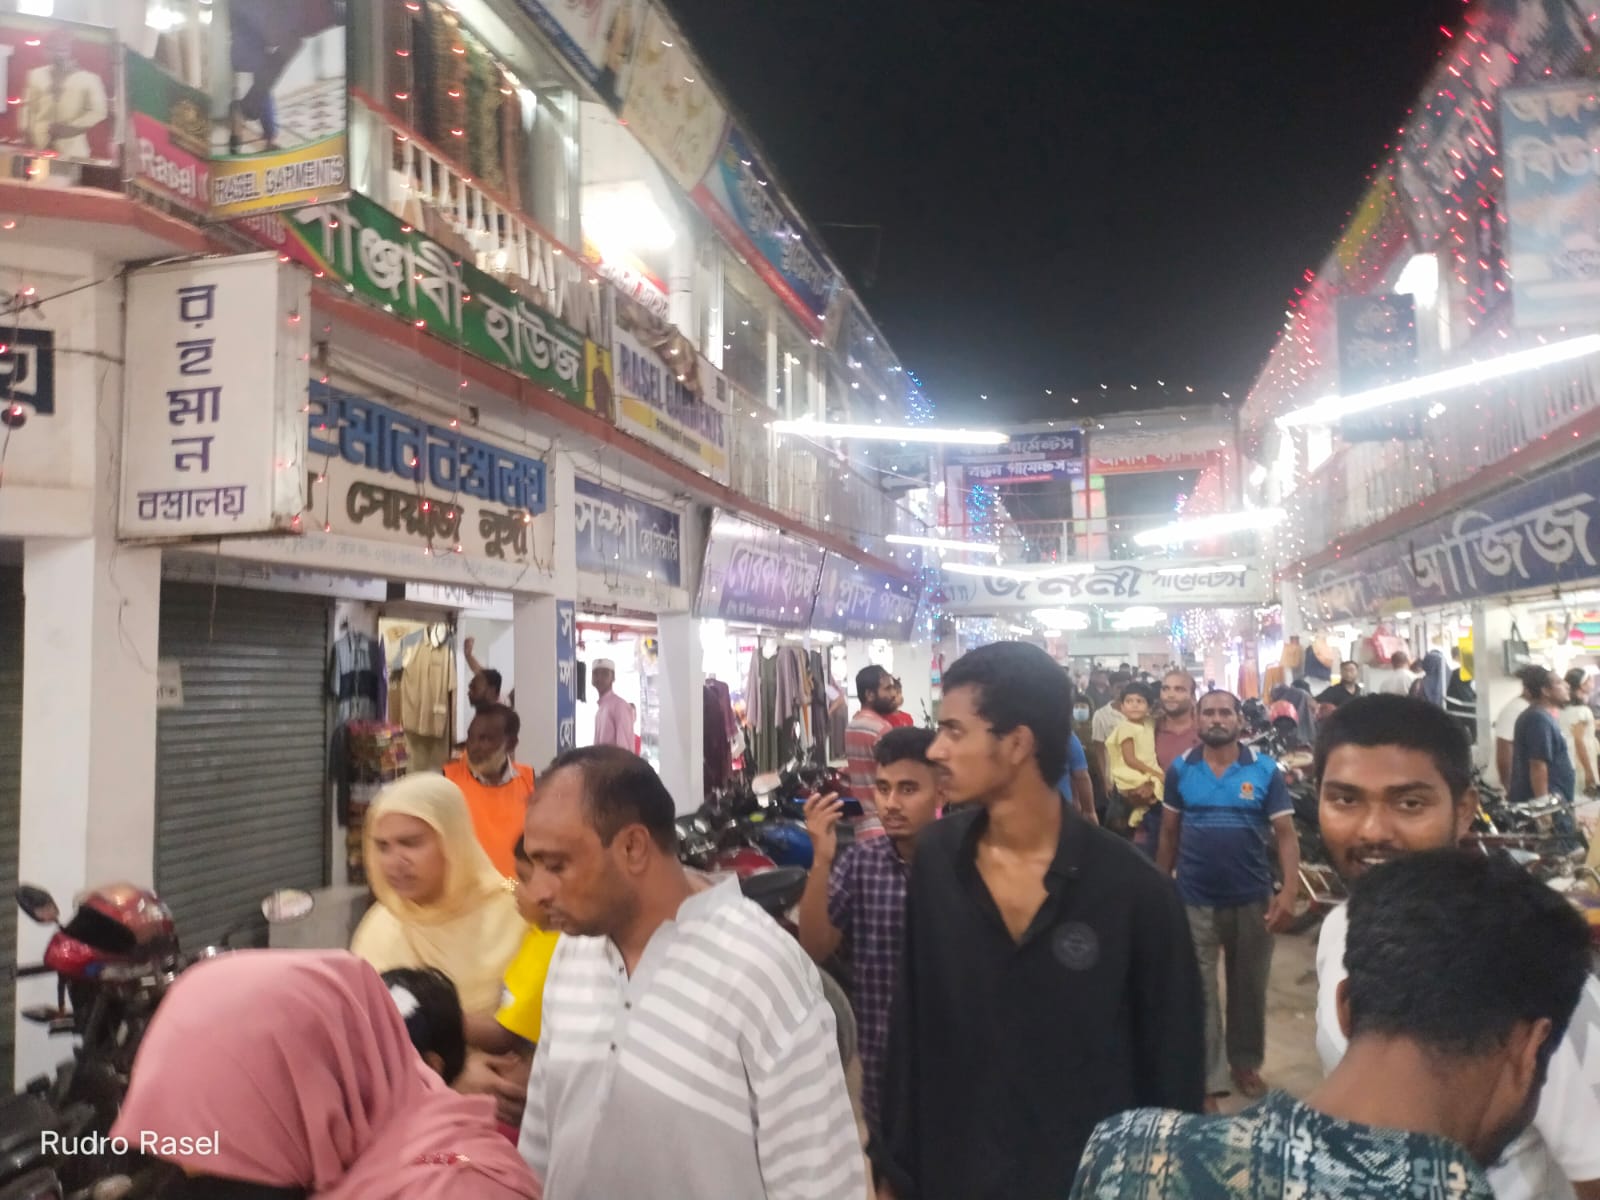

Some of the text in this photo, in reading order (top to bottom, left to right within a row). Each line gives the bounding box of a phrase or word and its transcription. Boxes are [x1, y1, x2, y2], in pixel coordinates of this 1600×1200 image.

[214, 170, 261, 207] RASEL
[478, 292, 582, 391] হাউজ
[137, 485, 247, 522] বস্ত্রালয়
[1402, 491, 1598, 597] আজিজ
